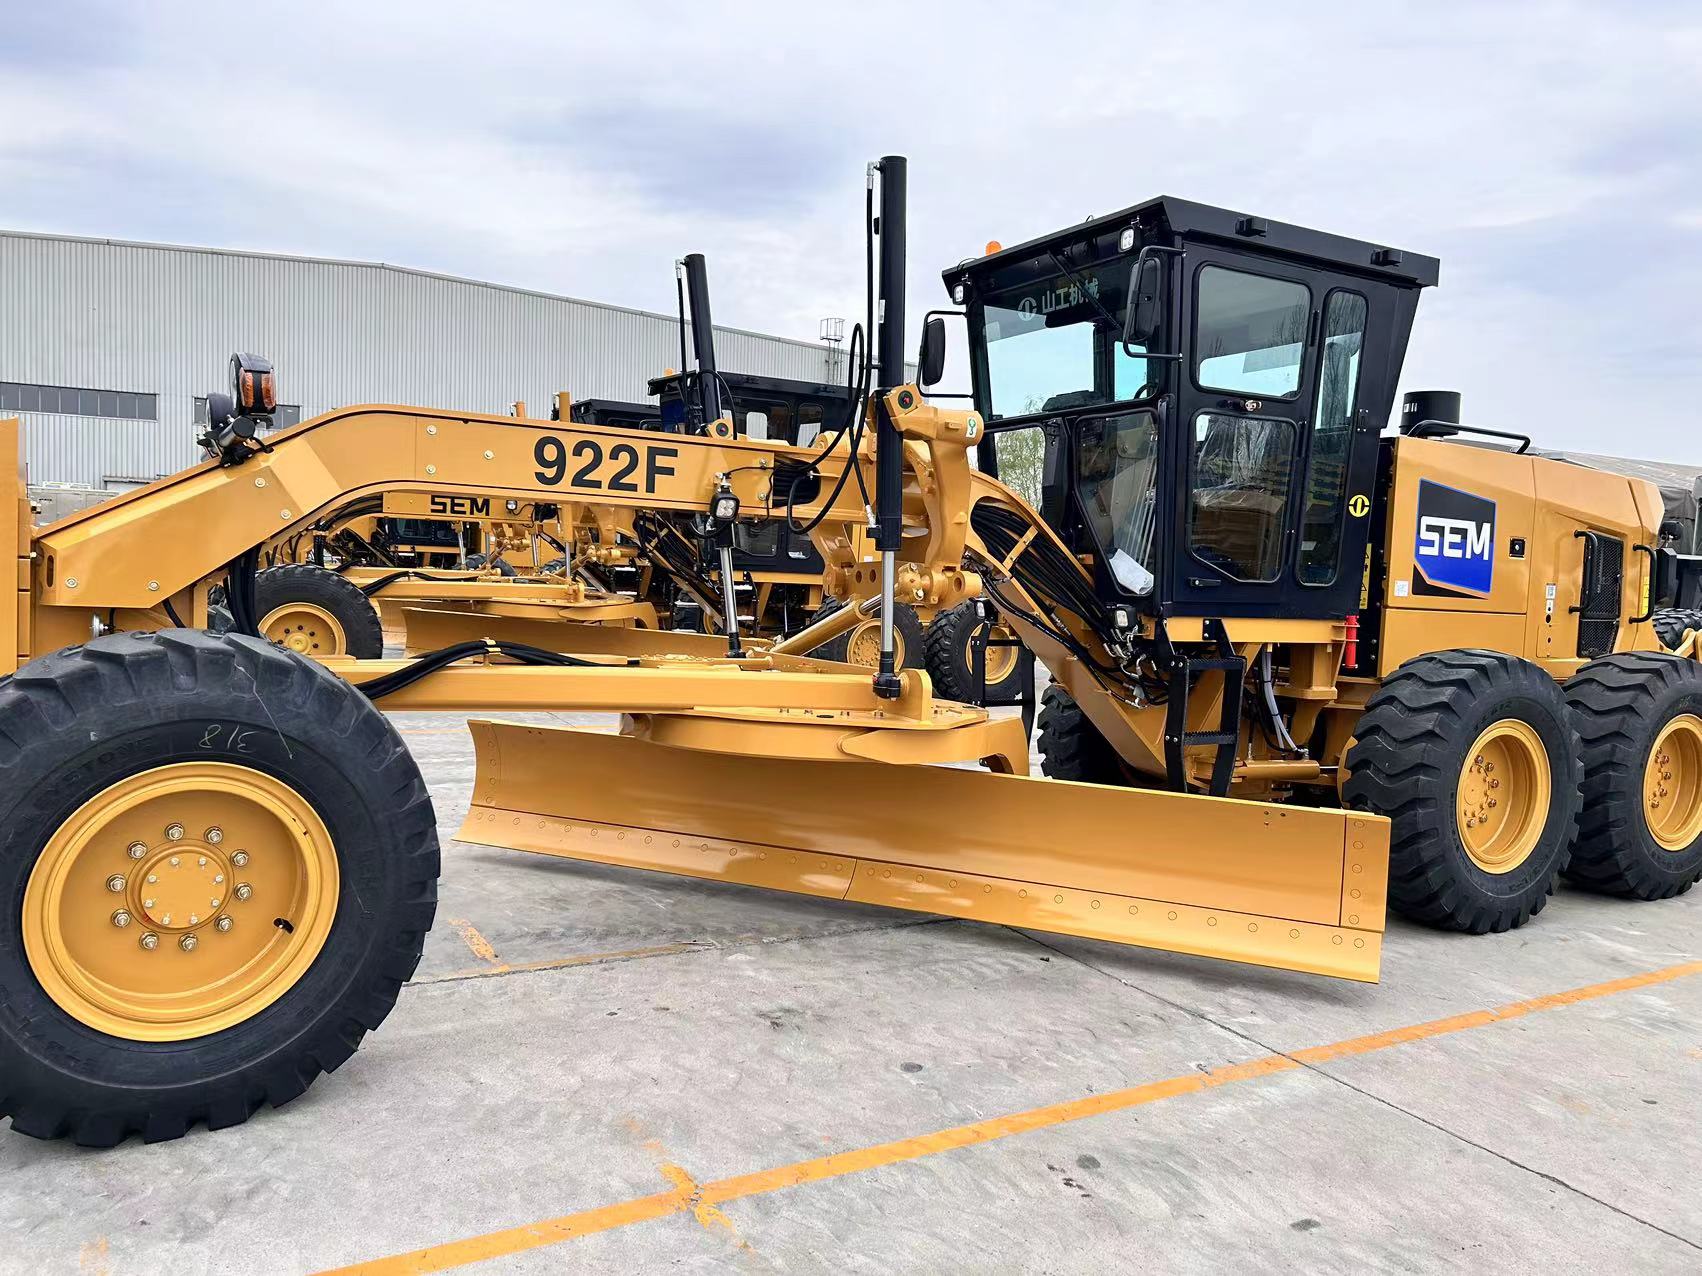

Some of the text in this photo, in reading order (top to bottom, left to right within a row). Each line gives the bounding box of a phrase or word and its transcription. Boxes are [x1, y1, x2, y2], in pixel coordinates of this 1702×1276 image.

[534, 436, 678, 493] 922F
[430, 495, 490, 517] SEM
[1418, 515, 1491, 561] SEM
